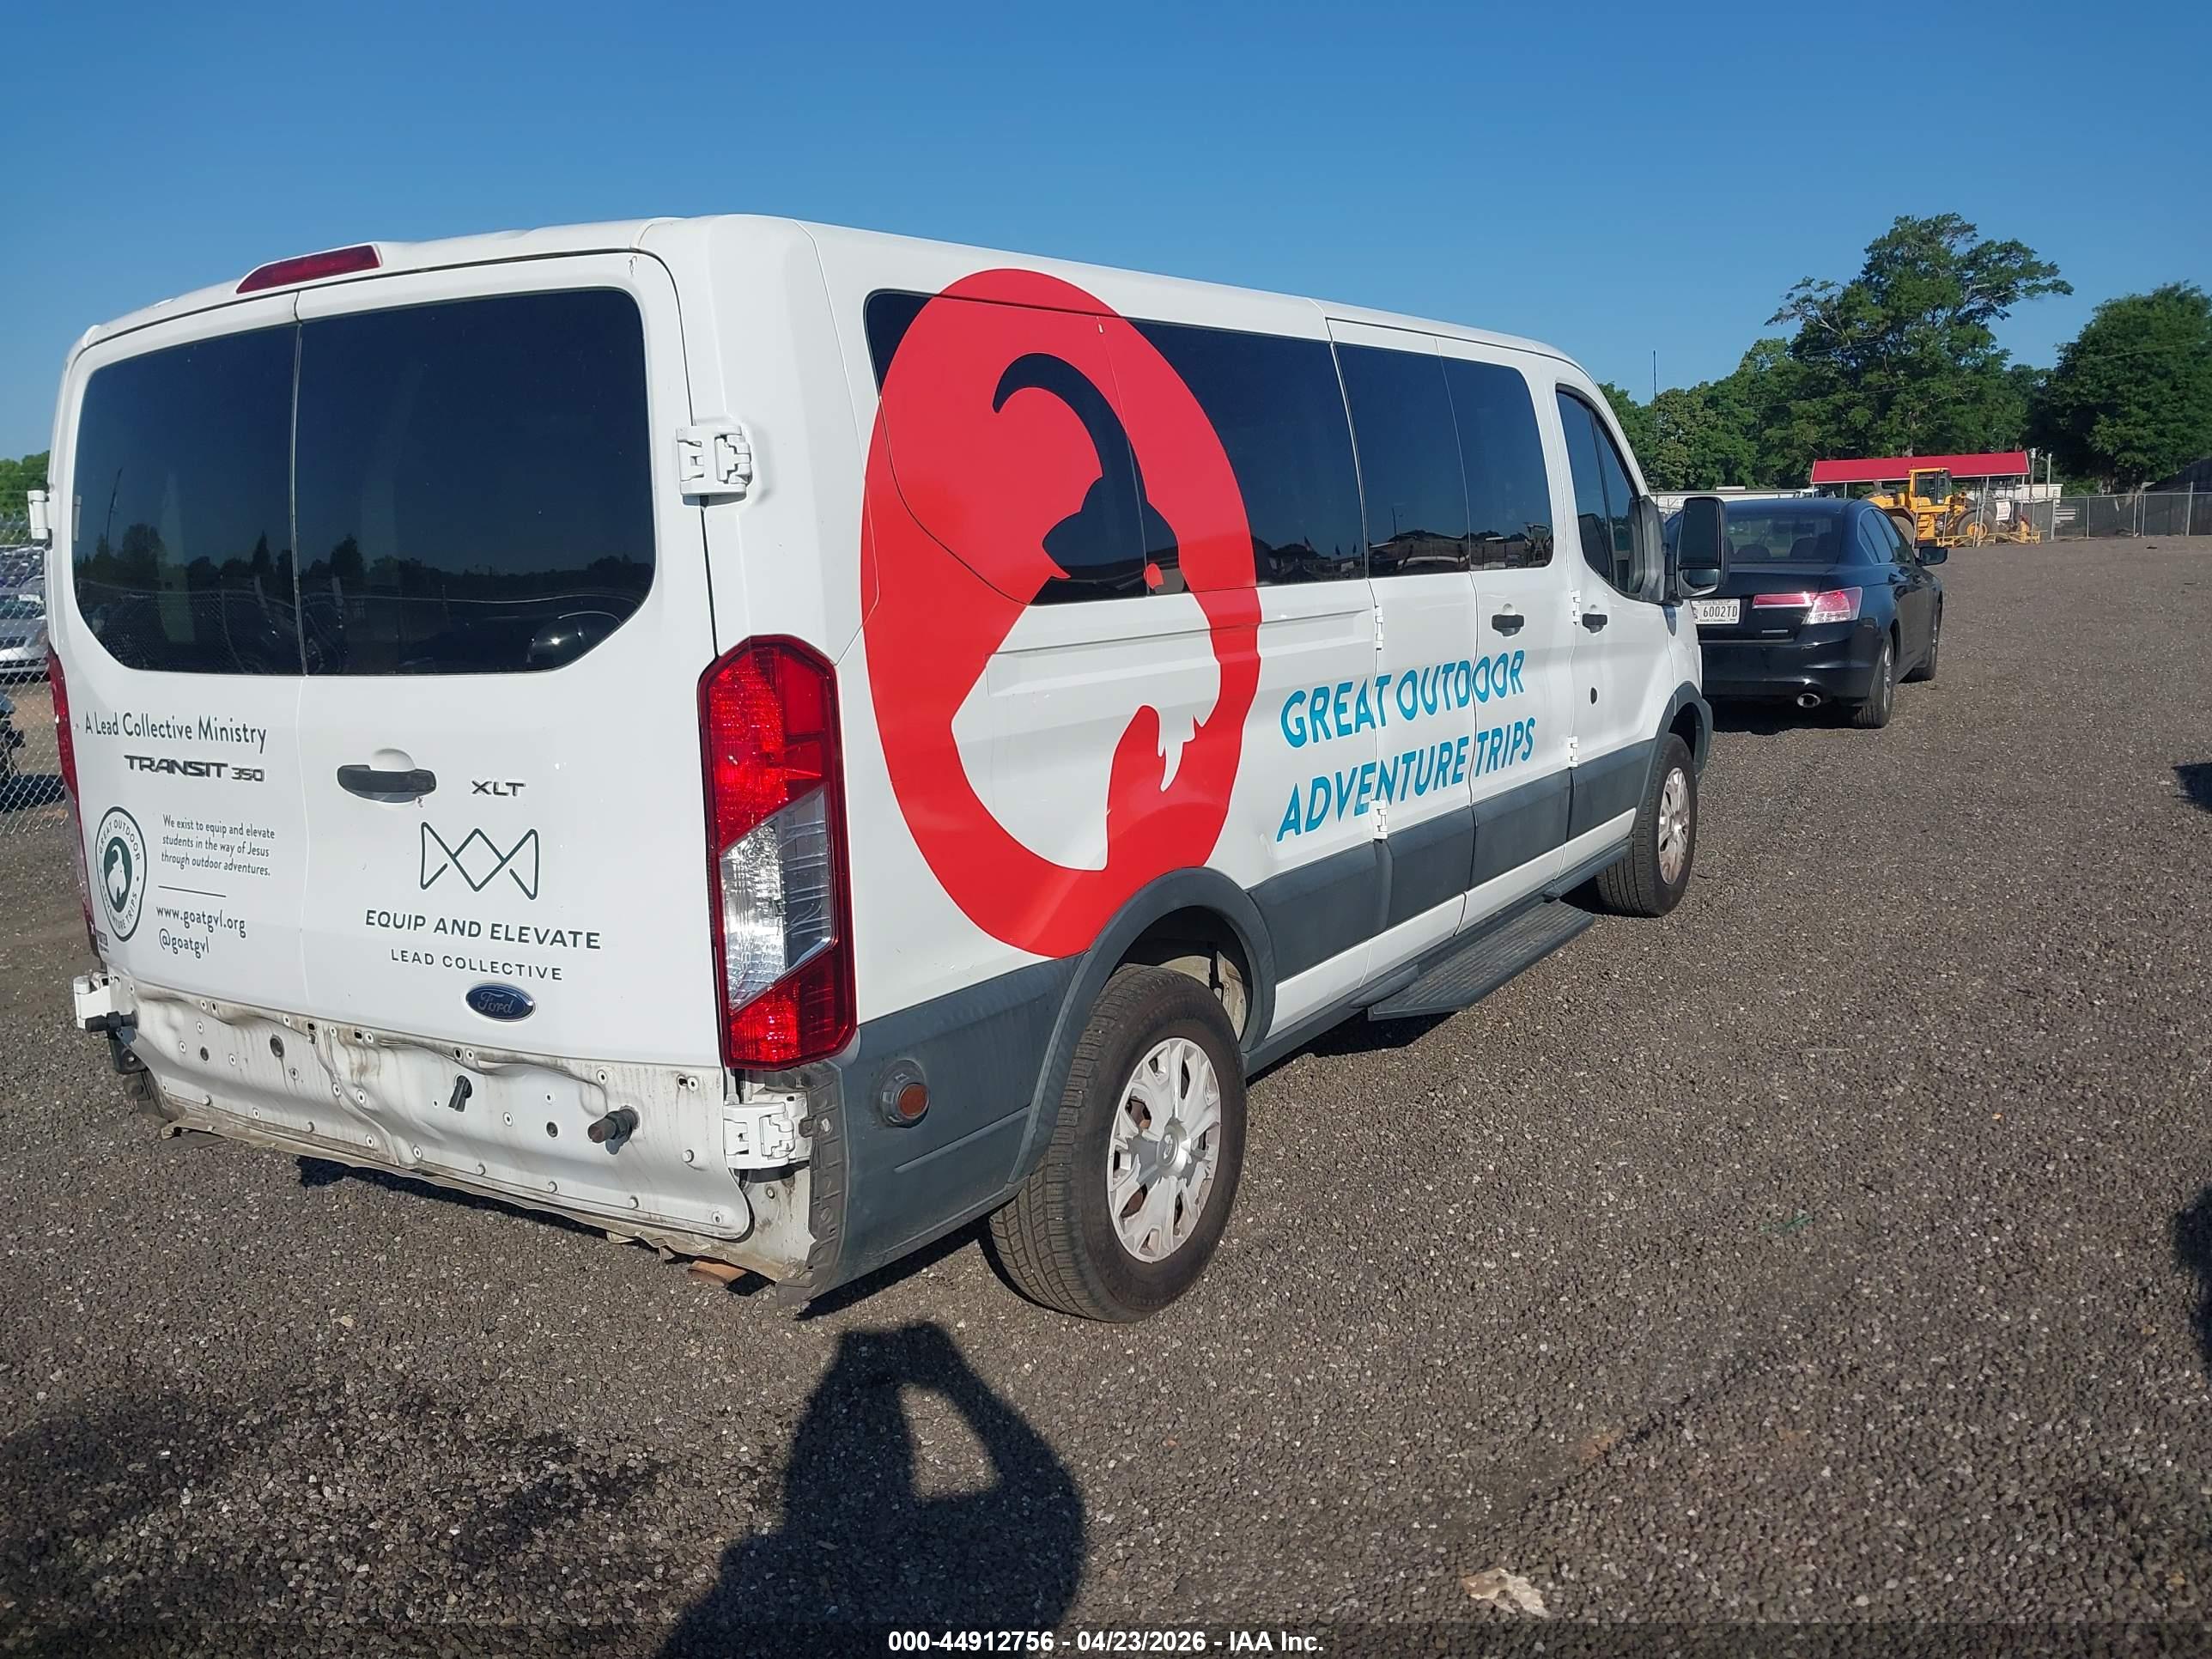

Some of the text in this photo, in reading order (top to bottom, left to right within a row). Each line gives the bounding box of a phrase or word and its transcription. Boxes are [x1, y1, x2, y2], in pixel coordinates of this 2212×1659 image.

[1703, 605, 1738, 617] 6002TD
[1280, 650, 1524, 748] GREAT OUTDOOR
[85, 711, 266, 754] A Lead Collective Ministry
[124, 755, 265, 782] TRANSIT 350
[1276, 717, 1535, 842] ADVENTURE TRIPS
[471, 780, 526, 796] XLT
[114, 819, 141, 861] OUTDOOR
[162, 813, 275, 839] We exist to equip and elevate
[162, 833, 269, 857] students in the way of Jesus
[161, 849, 270, 876] through outdoor adventures.
[156, 907, 246, 939] www.goatgvl.org
[365, 909, 601, 950] EQUIP AND ELEVATE
[159, 928, 210, 959] @goatgvl
[391, 949, 562, 981] LEAD COLLECTIVE
[477, 991, 514, 1013] Ford
